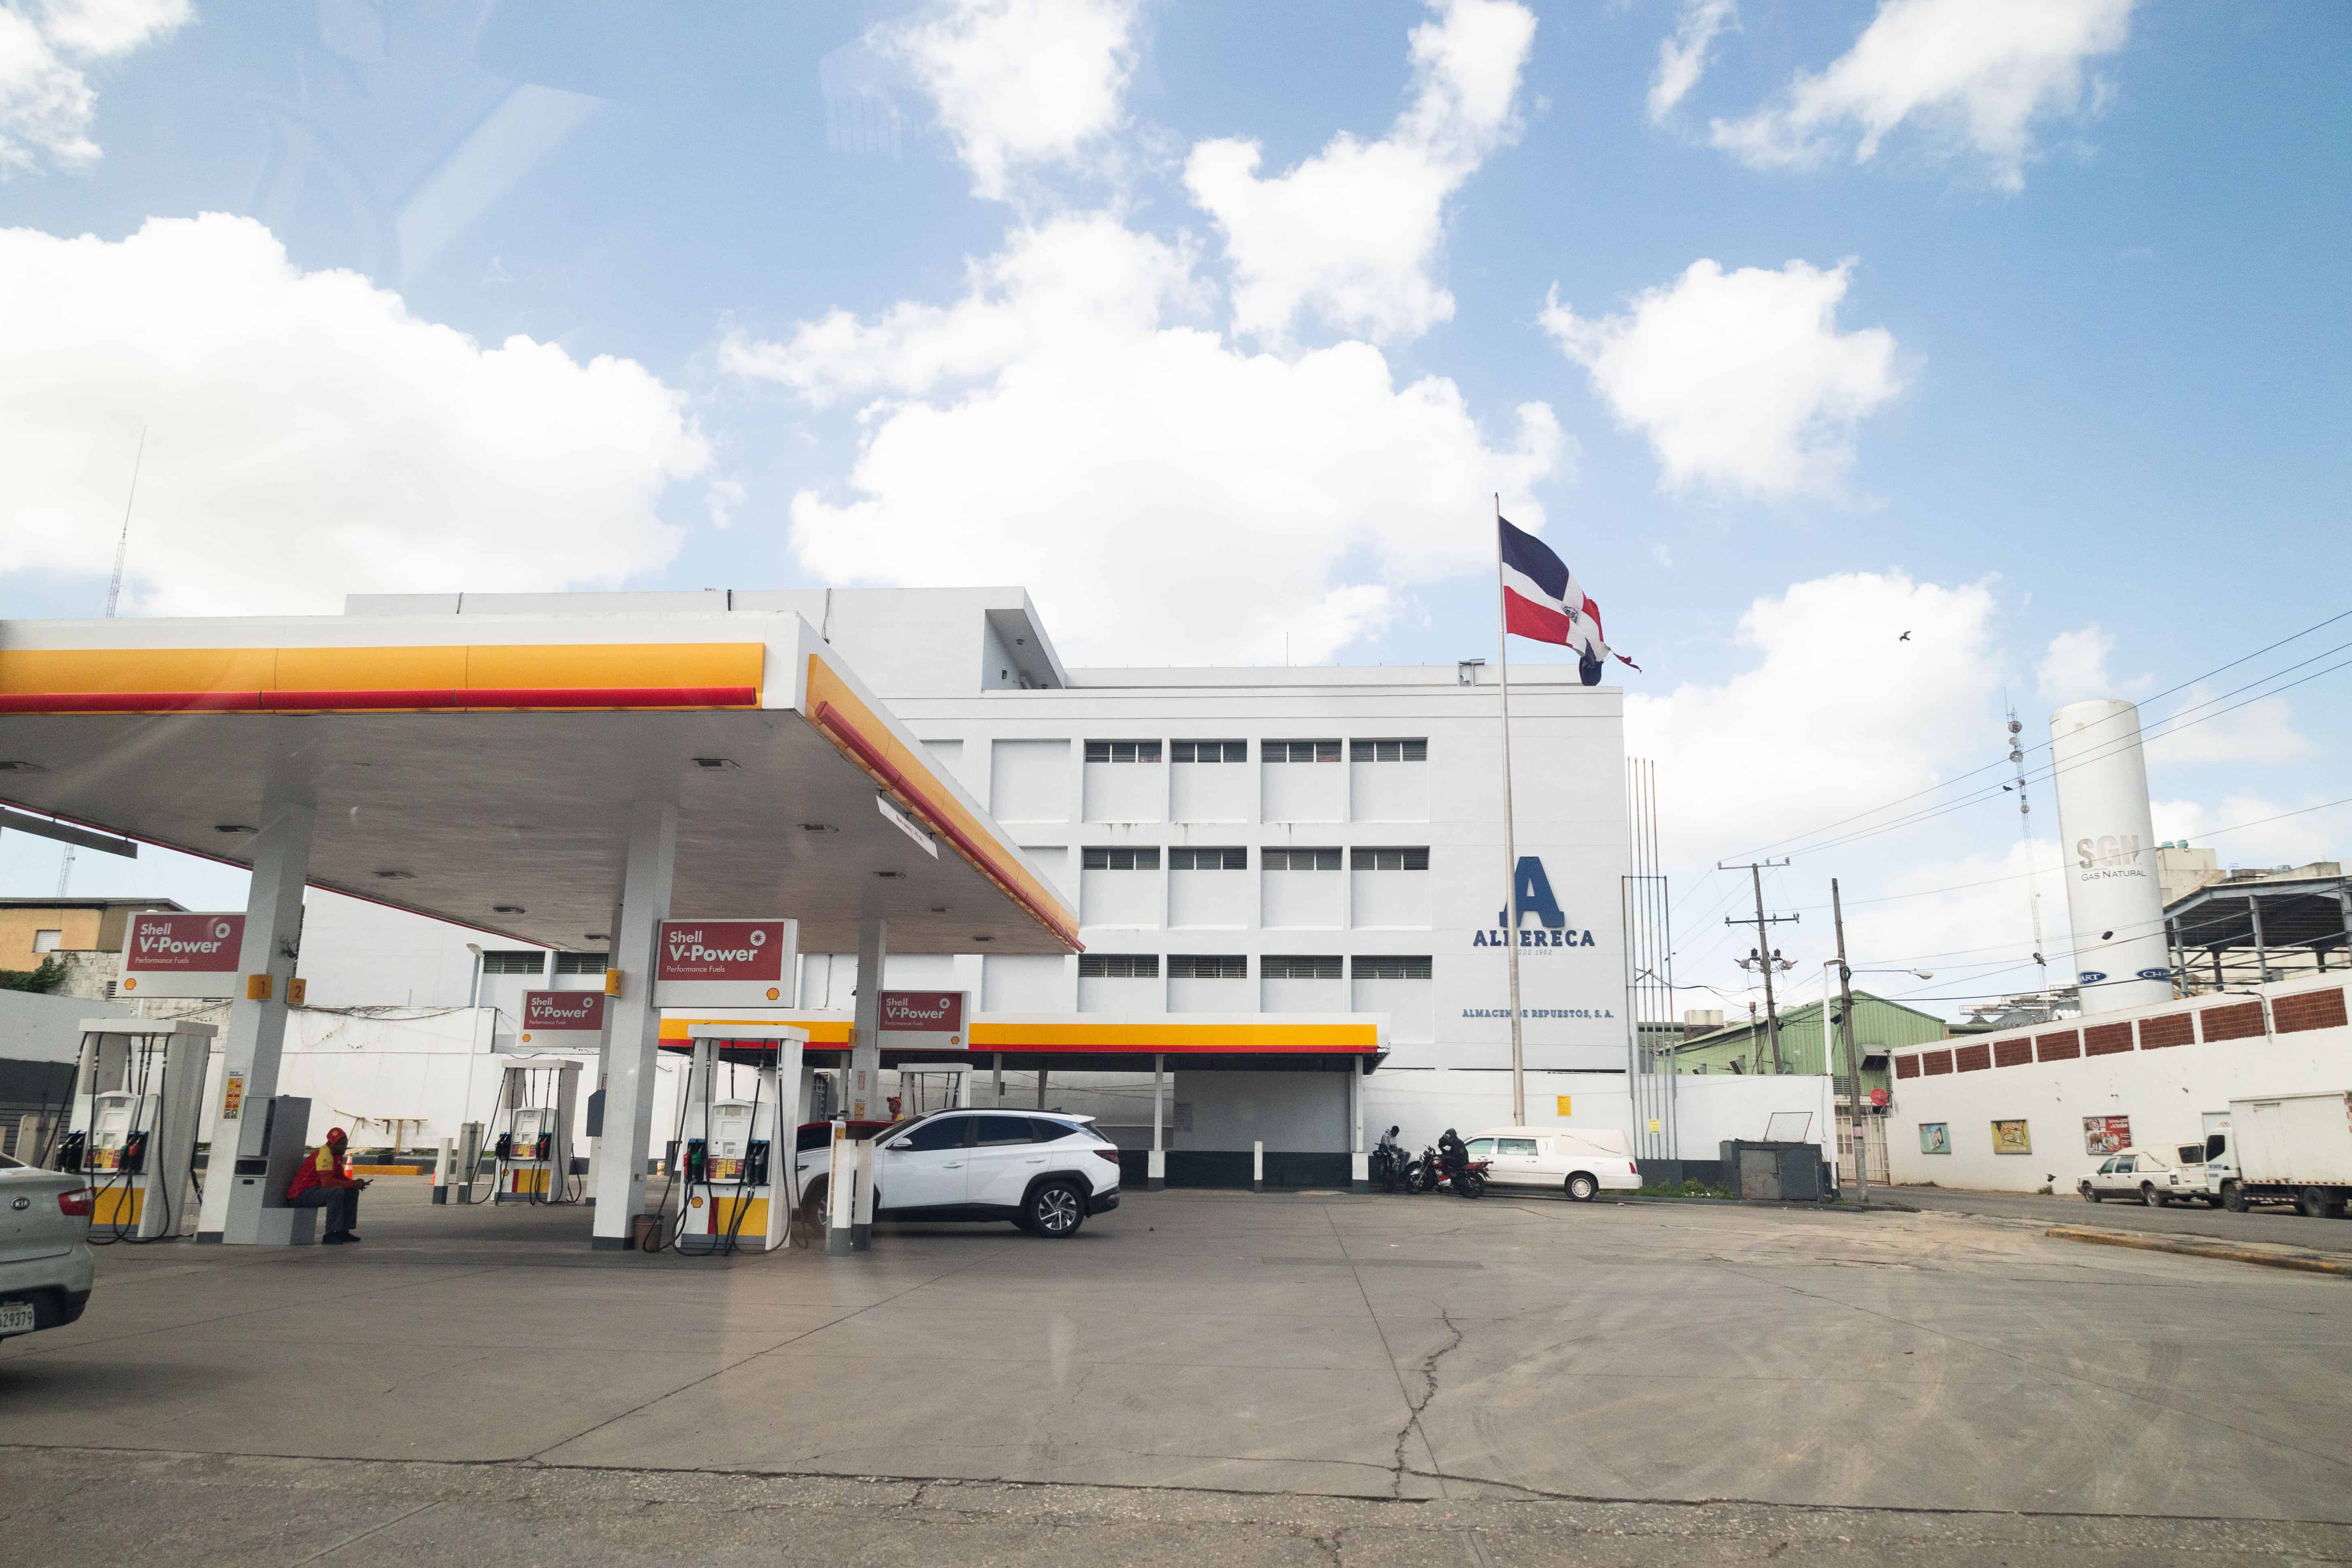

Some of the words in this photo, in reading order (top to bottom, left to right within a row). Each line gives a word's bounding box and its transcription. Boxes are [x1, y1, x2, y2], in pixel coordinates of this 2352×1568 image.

[2082, 873, 2099, 881] GAS
[2103, 870, 2146, 878] NATURAL
[1499, 856, 1565, 927] A
[140, 923, 172, 935] Shell
[669, 931, 702, 943] Shell
[140, 937, 221, 953] V-Power
[669, 945, 758, 961] V-Power
[261, 980, 266, 994] 1
[294, 985, 302, 999] 2
[531, 997, 552, 1005] Shell
[886, 998, 908, 1006] Shell
[531, 1007, 588, 1018] V-Power
[886, 1007, 945, 1019] V-Power
[1532, 1009, 1591, 1019] REPUESTOS,
[1594, 1009, 1602, 1018] S.
[1604, 1009, 1614, 1018] A.
